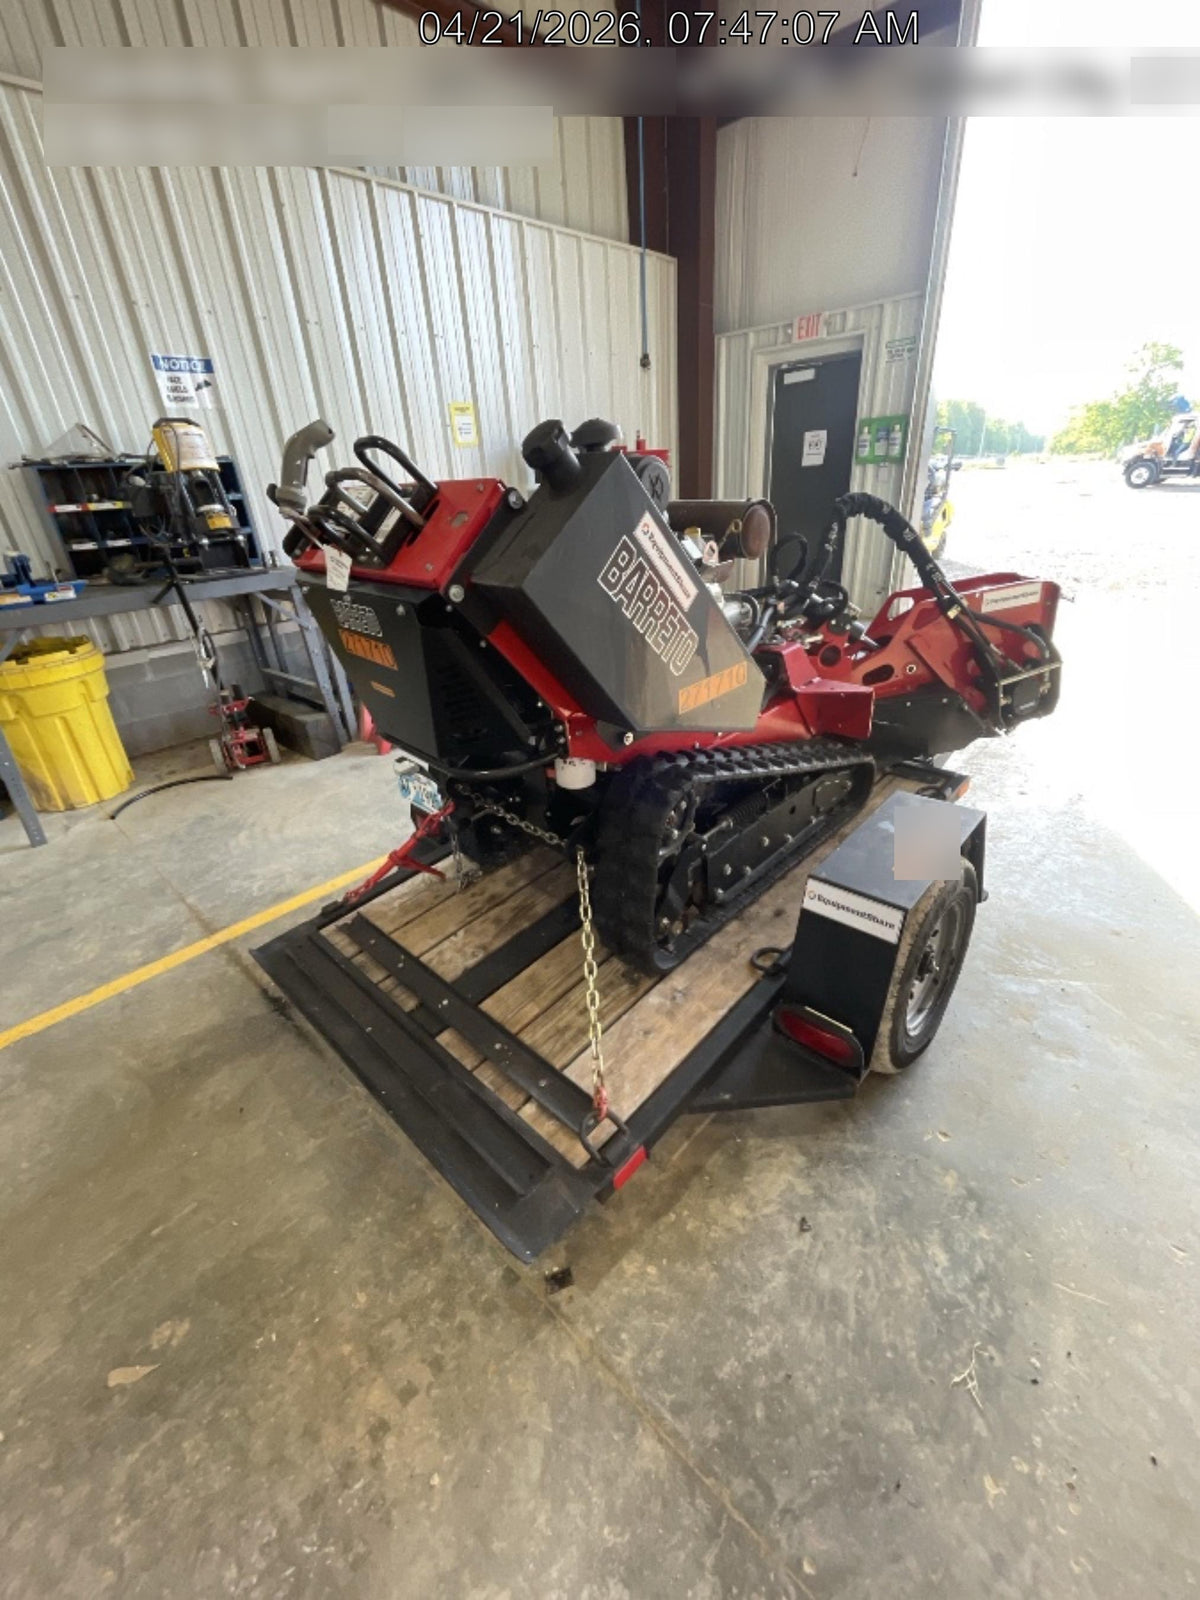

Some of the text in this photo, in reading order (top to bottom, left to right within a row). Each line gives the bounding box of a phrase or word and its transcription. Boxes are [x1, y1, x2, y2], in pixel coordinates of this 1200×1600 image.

[797, 313, 823, 340] EXIT
[597, 534, 699, 676] BARRETO
[680, 665, 747, 712] 271710
[817, 893, 896, 930] EquipmentShare
